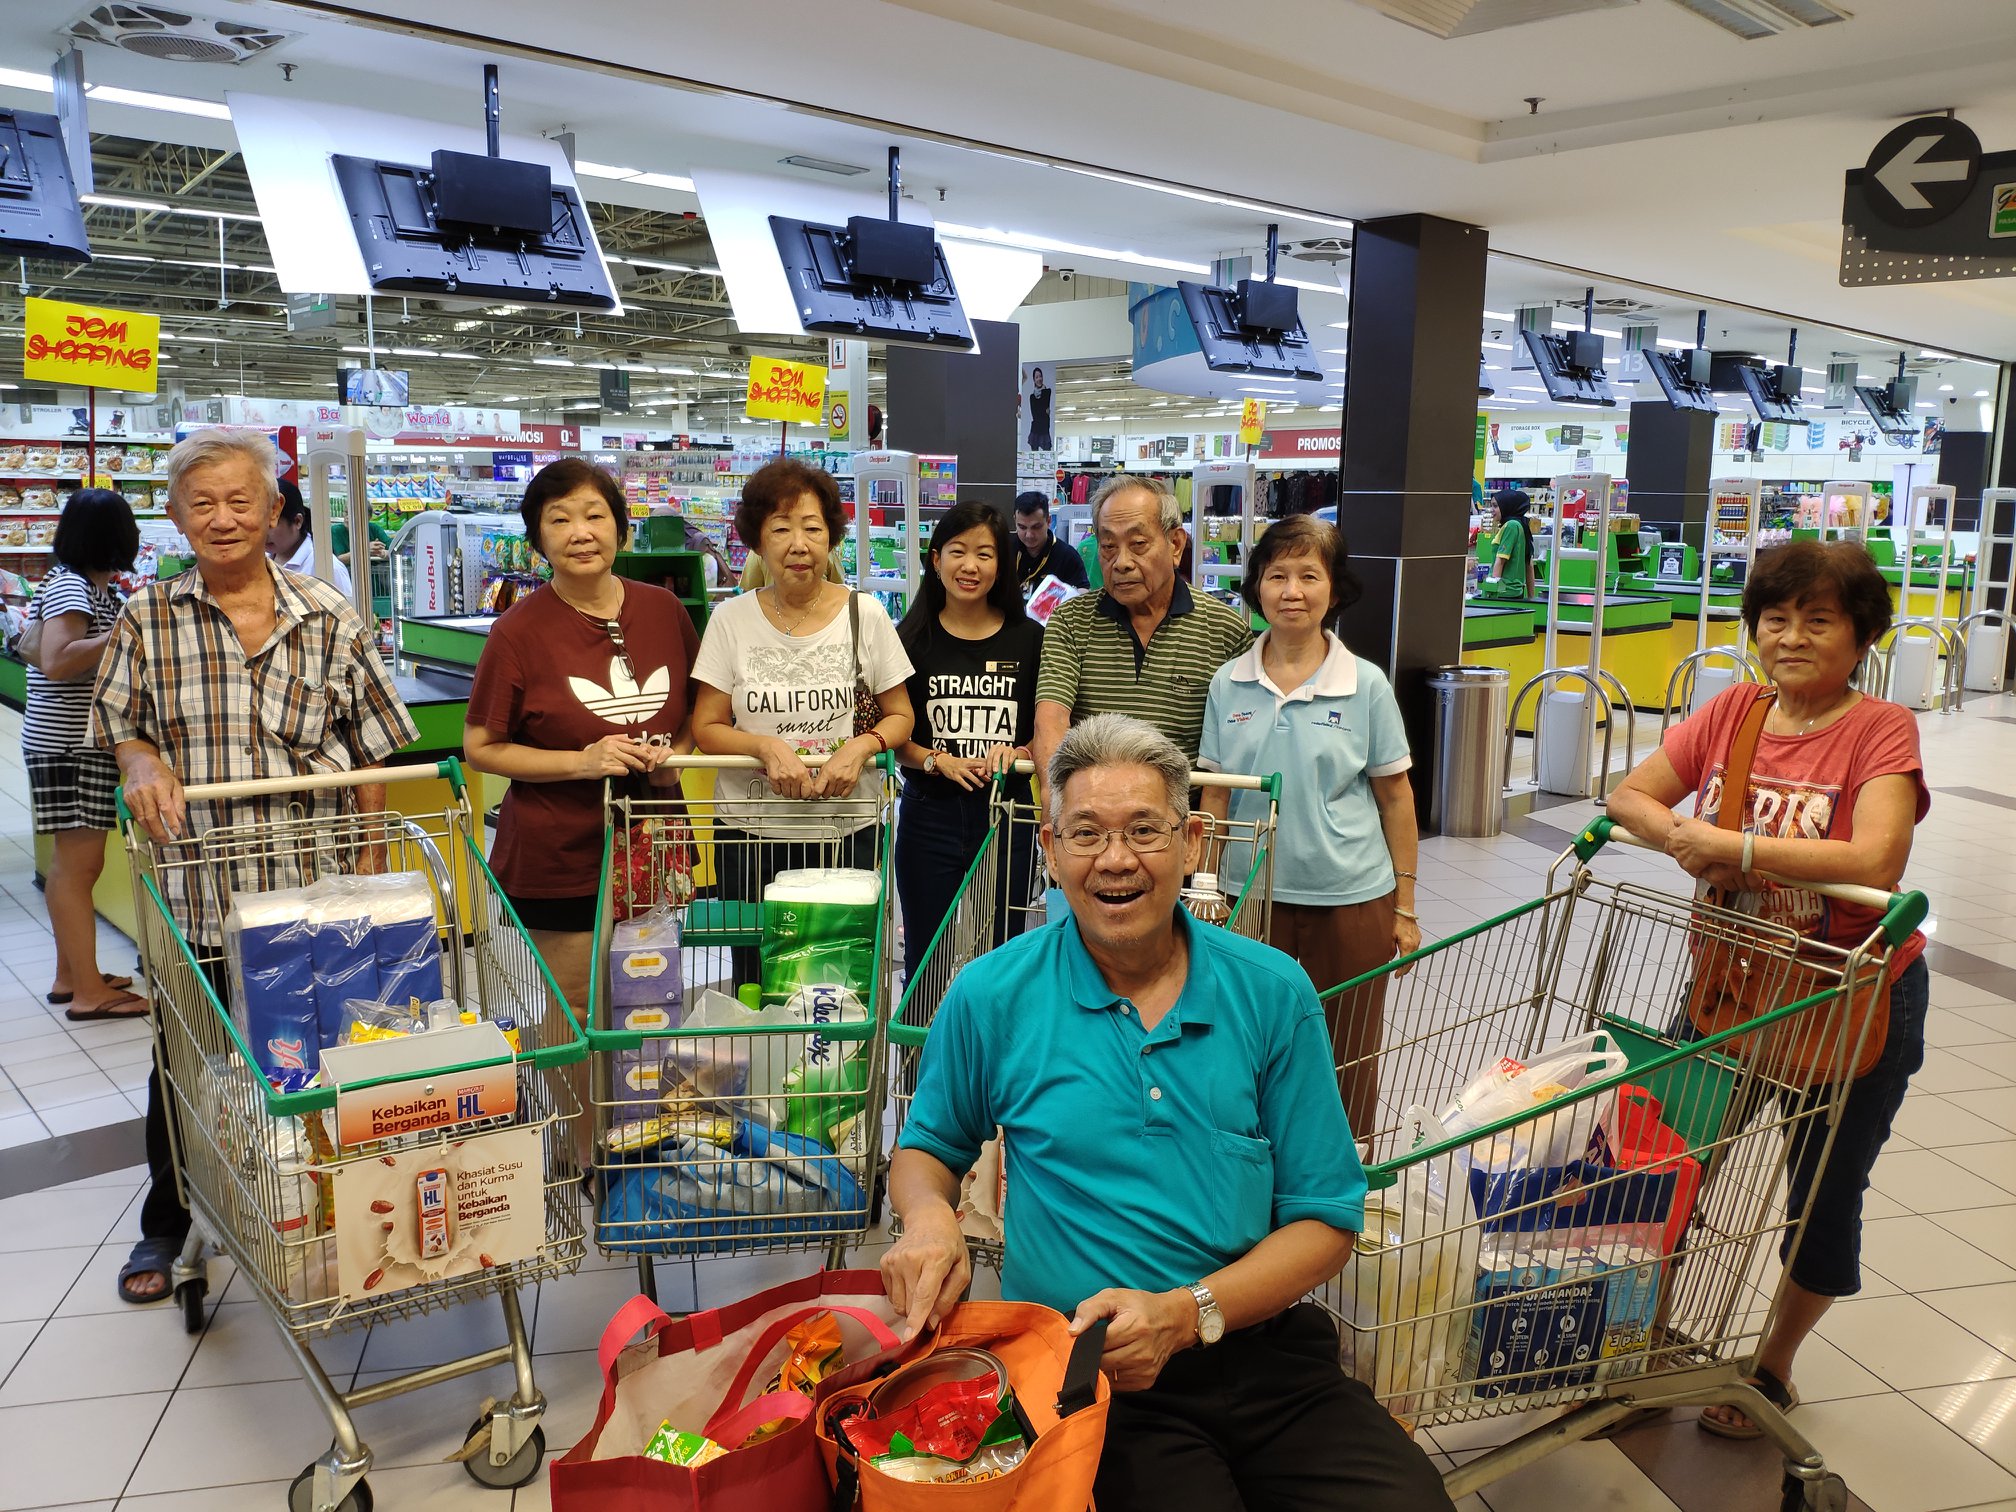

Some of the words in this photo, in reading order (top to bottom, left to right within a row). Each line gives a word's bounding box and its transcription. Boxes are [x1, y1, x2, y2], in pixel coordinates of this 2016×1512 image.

[66, 315, 128, 343] JOM
[26, 334, 152, 370] SHOPPING
[1622, 353, 1644, 372] 13
[770, 367, 804, 387] JOM
[749, 382, 820, 408] SHOPPING
[1826, 385, 1847, 401] 14
[405, 412, 451, 425] World
[1093, 441, 1101, 449] 23
[1167, 440, 1175, 448] 22
[426, 545, 435, 577] Bull
[427, 578, 436, 611] Red
[928, 675, 1016, 698] STRAIGHT
[746, 686, 855, 713] CALIFORNI
[776, 712, 847, 734] sunset
[933, 705, 1012, 735] OUTTA
[956, 739, 1013, 758] TUN
[1701, 776, 1830, 839] PRIS
[372, 1098, 447, 1121] Kebaikan
[457, 1094, 485, 1119] HL
[372, 1111, 450, 1135] Berganda
[457, 1166, 496, 1181] Khasiat
[498, 1161, 523, 1172] Susu
[457, 1181, 477, 1191] dan
[480, 1173, 515, 1186] Kurma
[424, 1190, 441, 1206] HL
[457, 1188, 488, 1201] untuk
[458, 1194, 507, 1211] Kebaikan
[458, 1203, 510, 1221] Berganda
